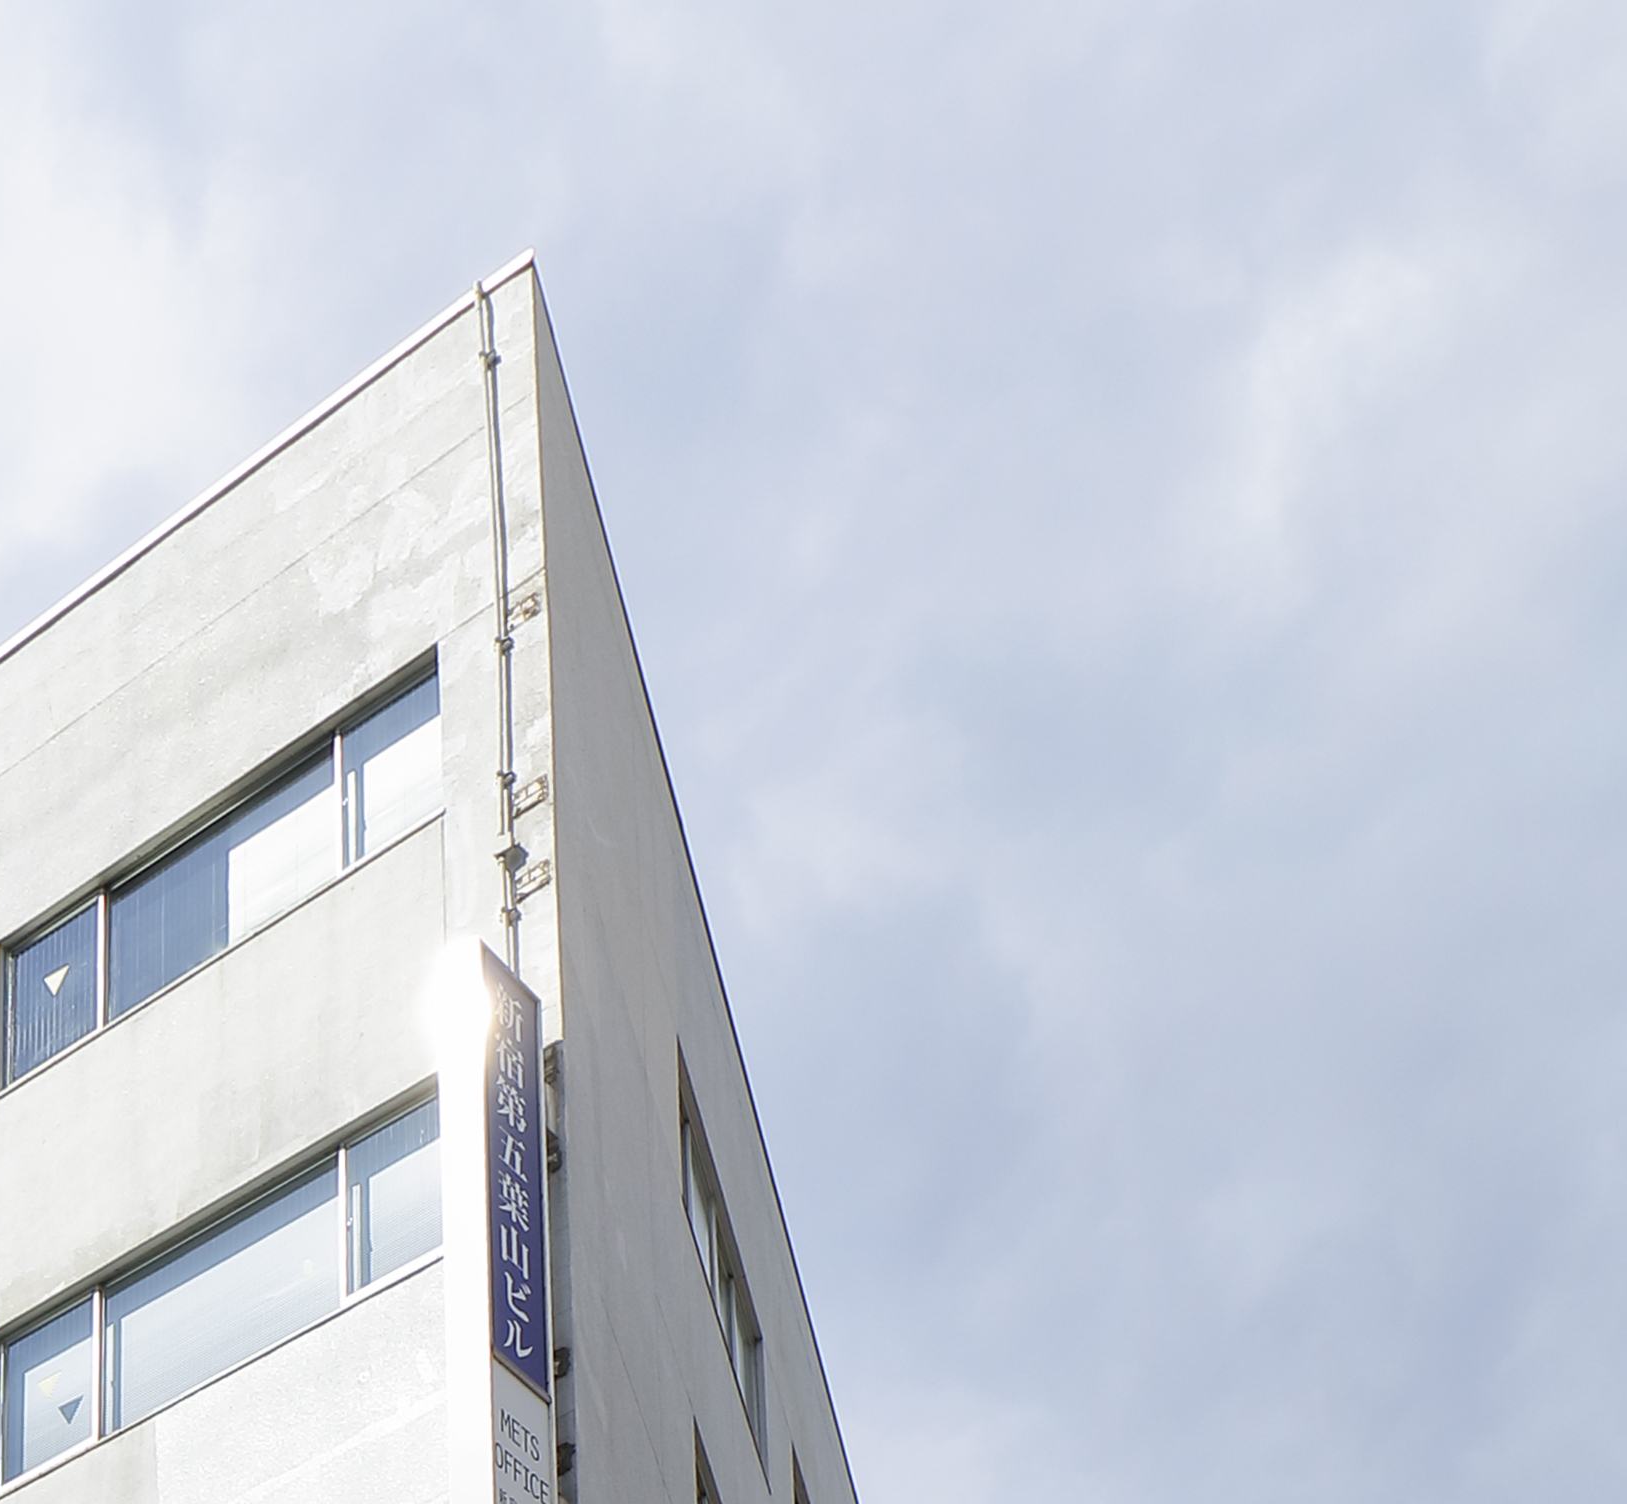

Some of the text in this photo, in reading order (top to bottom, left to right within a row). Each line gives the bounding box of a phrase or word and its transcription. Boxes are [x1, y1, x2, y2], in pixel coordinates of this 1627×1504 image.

[493, 982, 534, 1359] 新宿第五葉山ビル
[500, 1408, 540, 1462] METS
